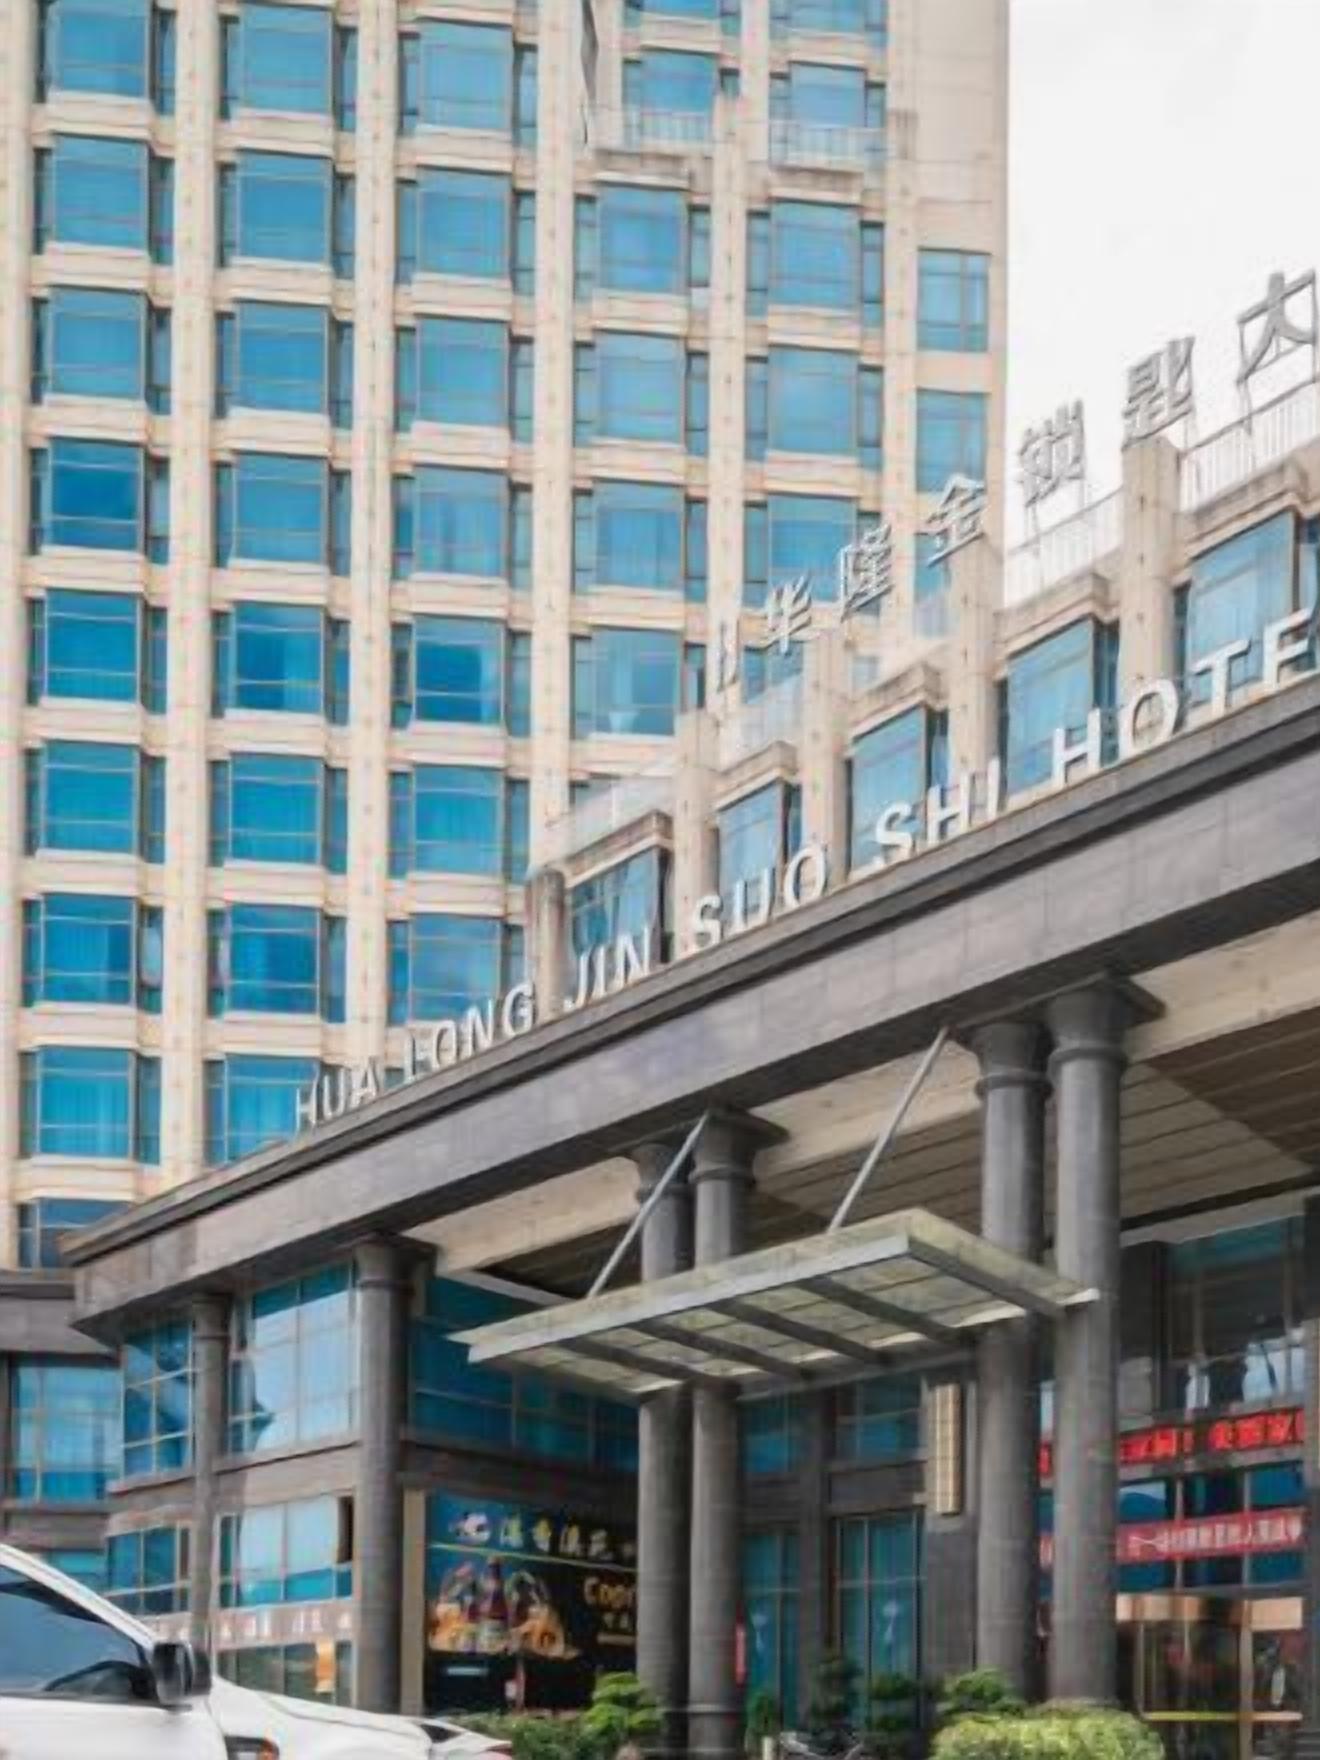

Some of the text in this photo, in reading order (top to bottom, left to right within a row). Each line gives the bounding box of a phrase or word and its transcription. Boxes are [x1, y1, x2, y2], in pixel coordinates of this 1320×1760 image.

[295, 1057, 381, 1136] HUA
[563, 924, 651, 1011] JIN
[687, 841, 829, 957] SUO
[871, 757, 1002, 870] SHI
